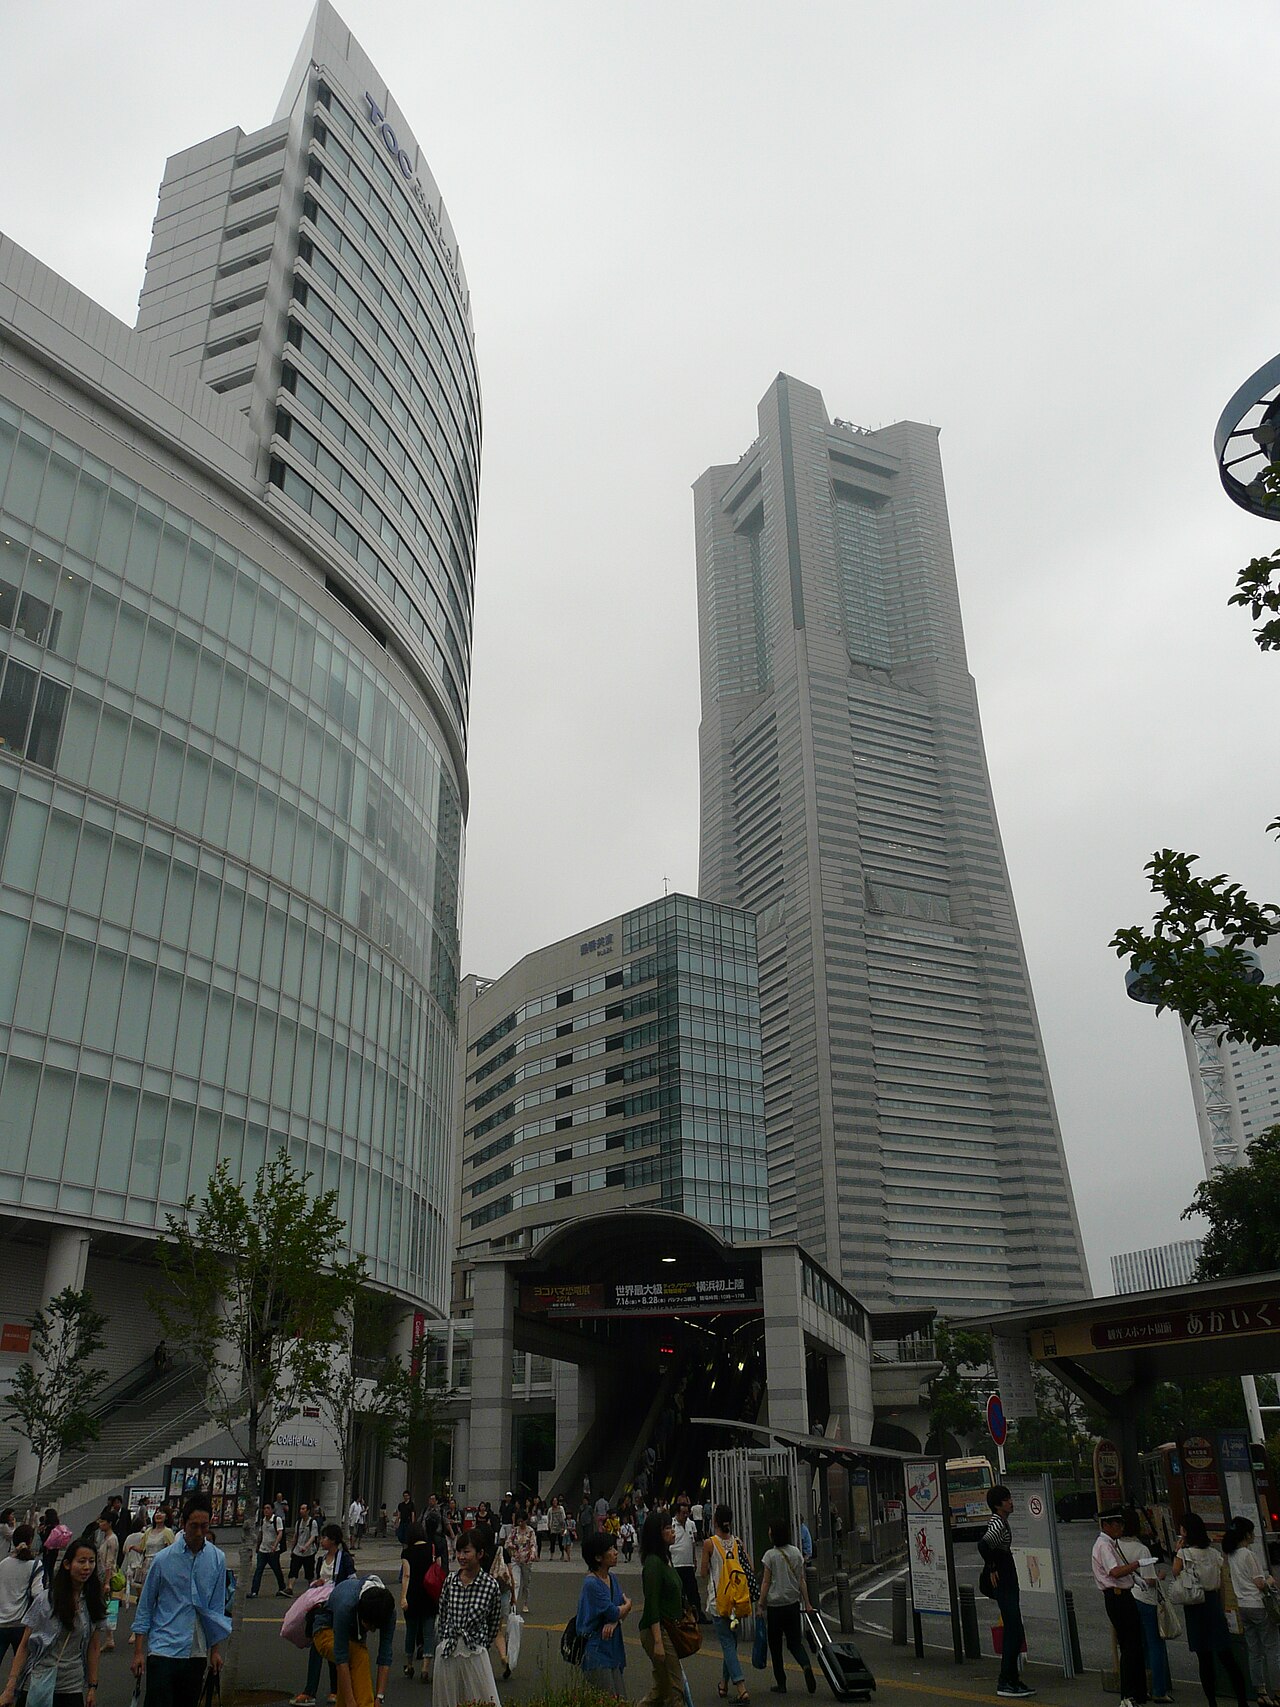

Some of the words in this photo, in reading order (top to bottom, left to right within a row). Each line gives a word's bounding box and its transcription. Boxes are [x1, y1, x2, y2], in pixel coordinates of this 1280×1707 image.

[365, 91, 413, 180] TOC
[615, 1283, 663, 1297] 世界最大級
[697, 1278, 745, 1293] 横浜初上陸
[1186, 1303, 1280, 1335] あかいく
